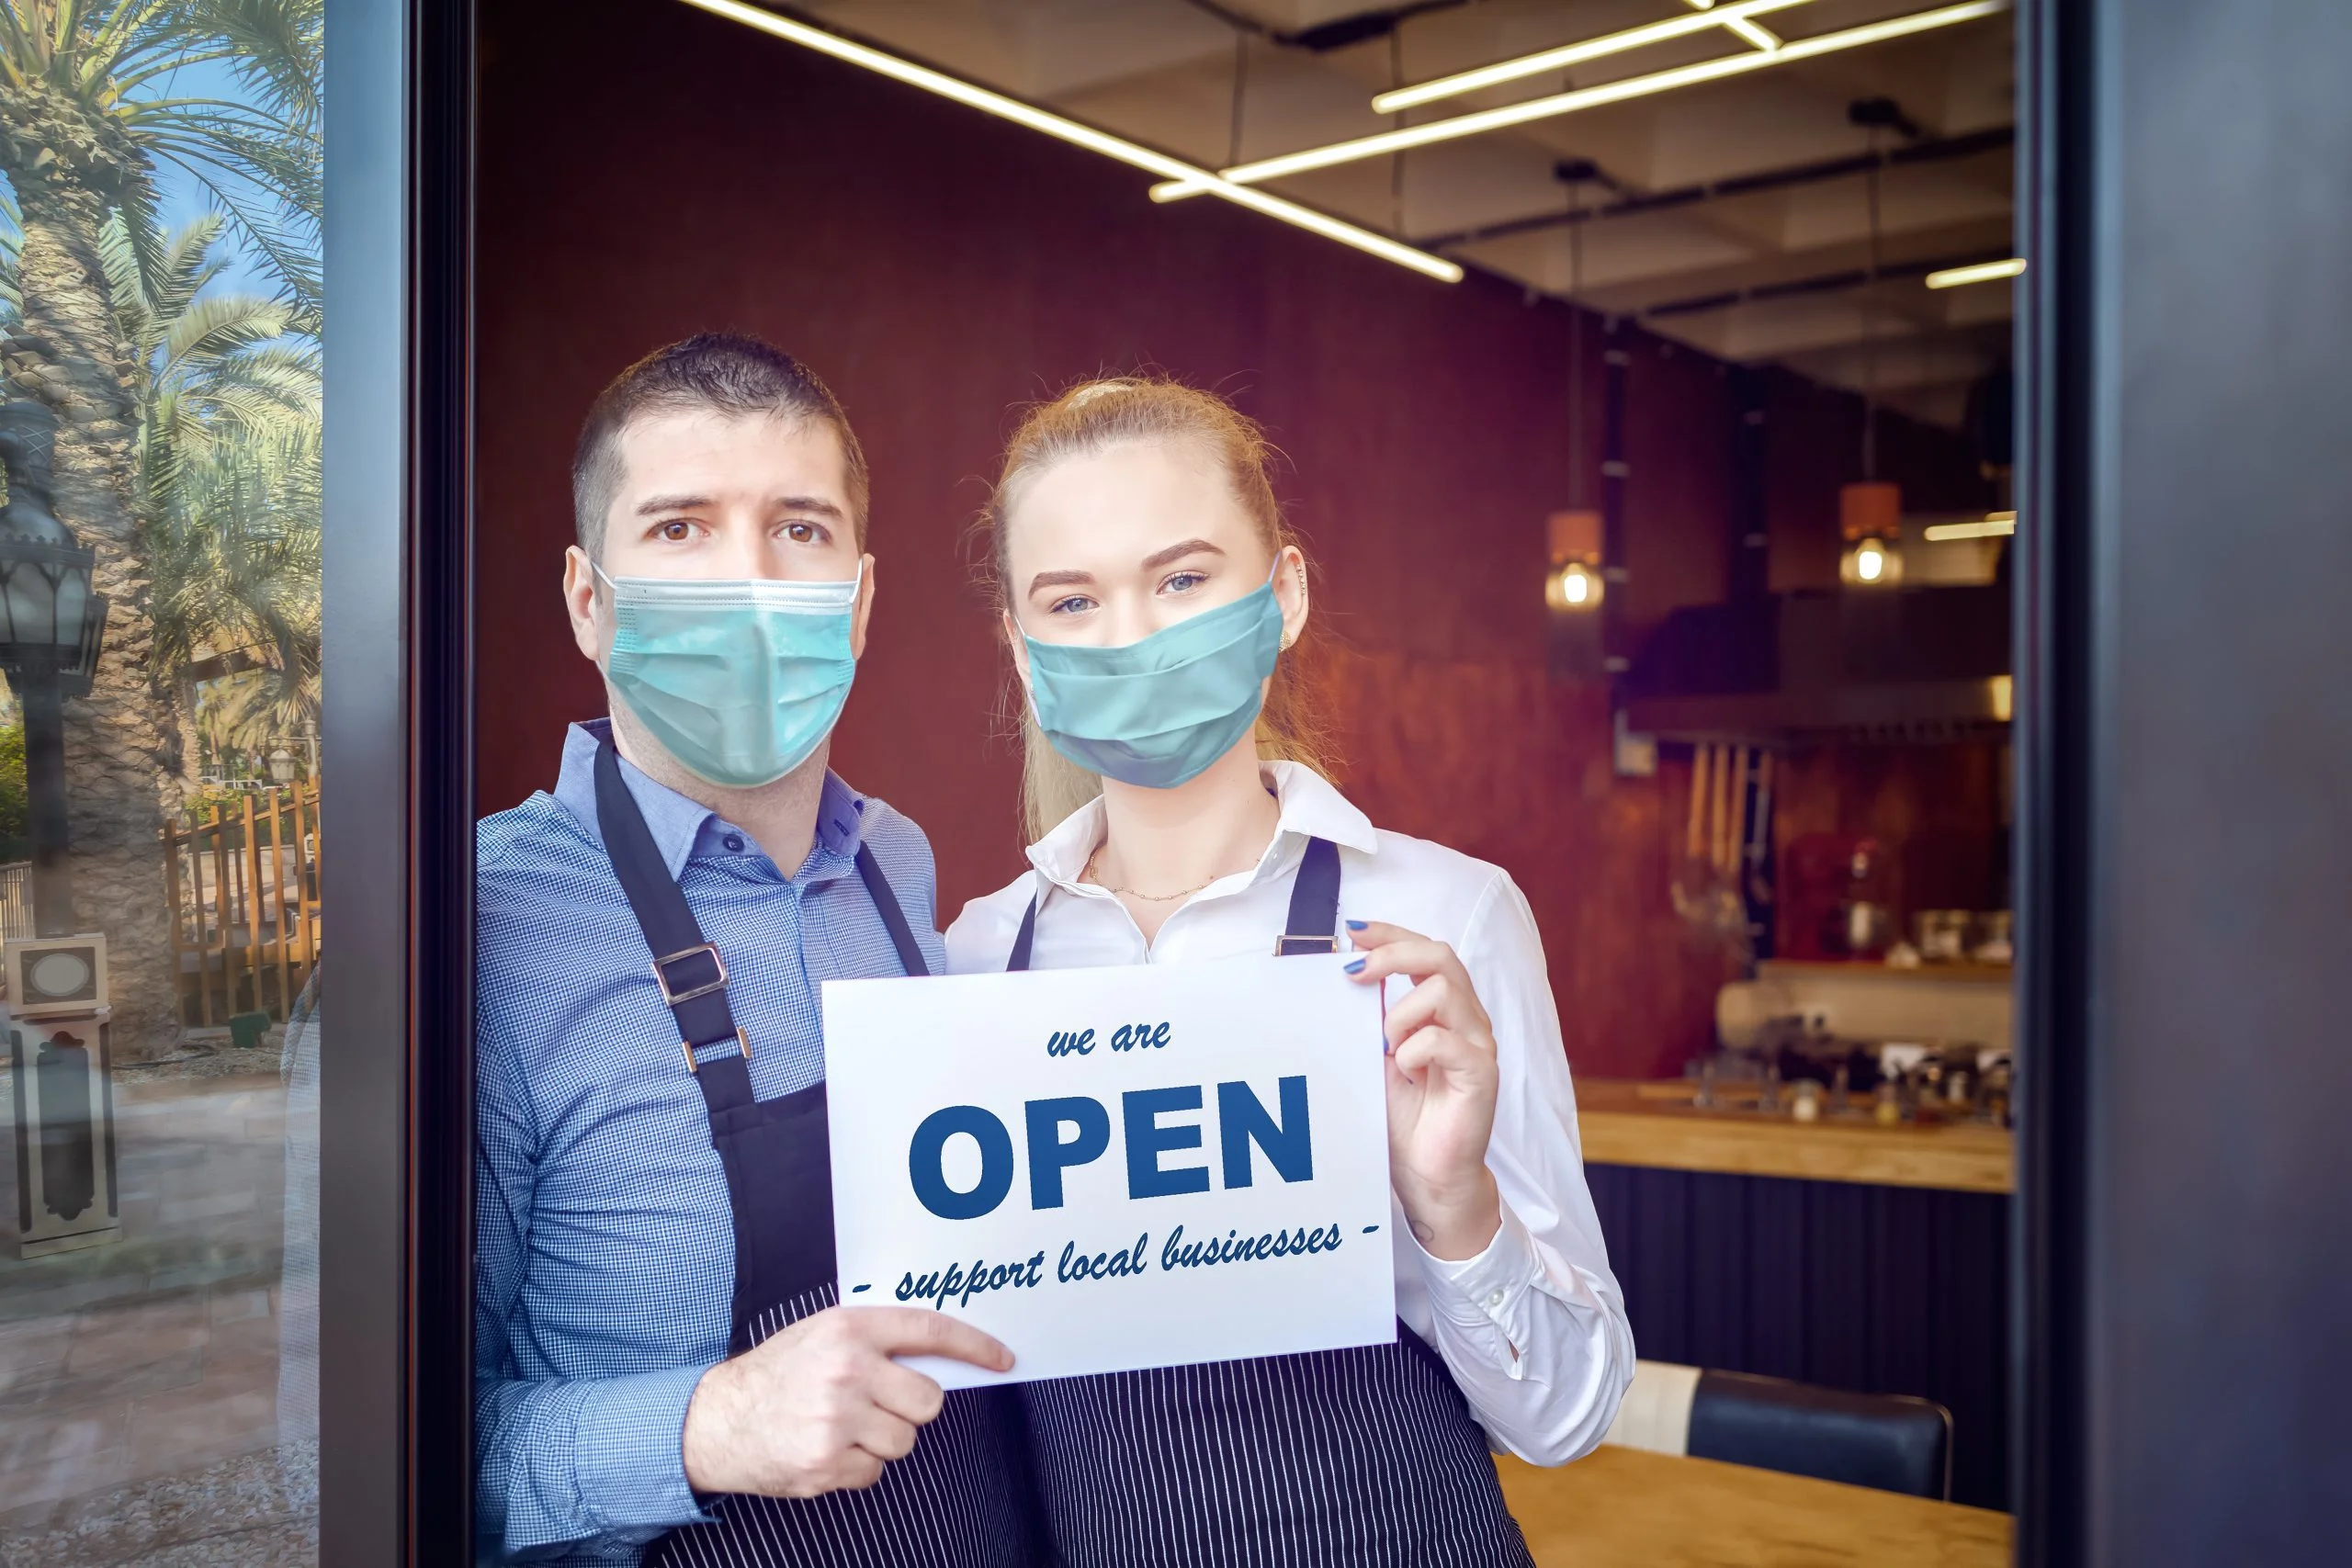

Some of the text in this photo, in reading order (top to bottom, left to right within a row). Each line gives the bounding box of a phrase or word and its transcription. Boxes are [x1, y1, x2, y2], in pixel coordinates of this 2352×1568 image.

[1046, 1021, 1171, 1058] we are
[909, 1075, 1314, 1221] OPEN
[895, 1250, 1046, 1311] support
[1057, 1232, 1148, 1283] local
[1160, 1224, 1343, 1271] businesses
